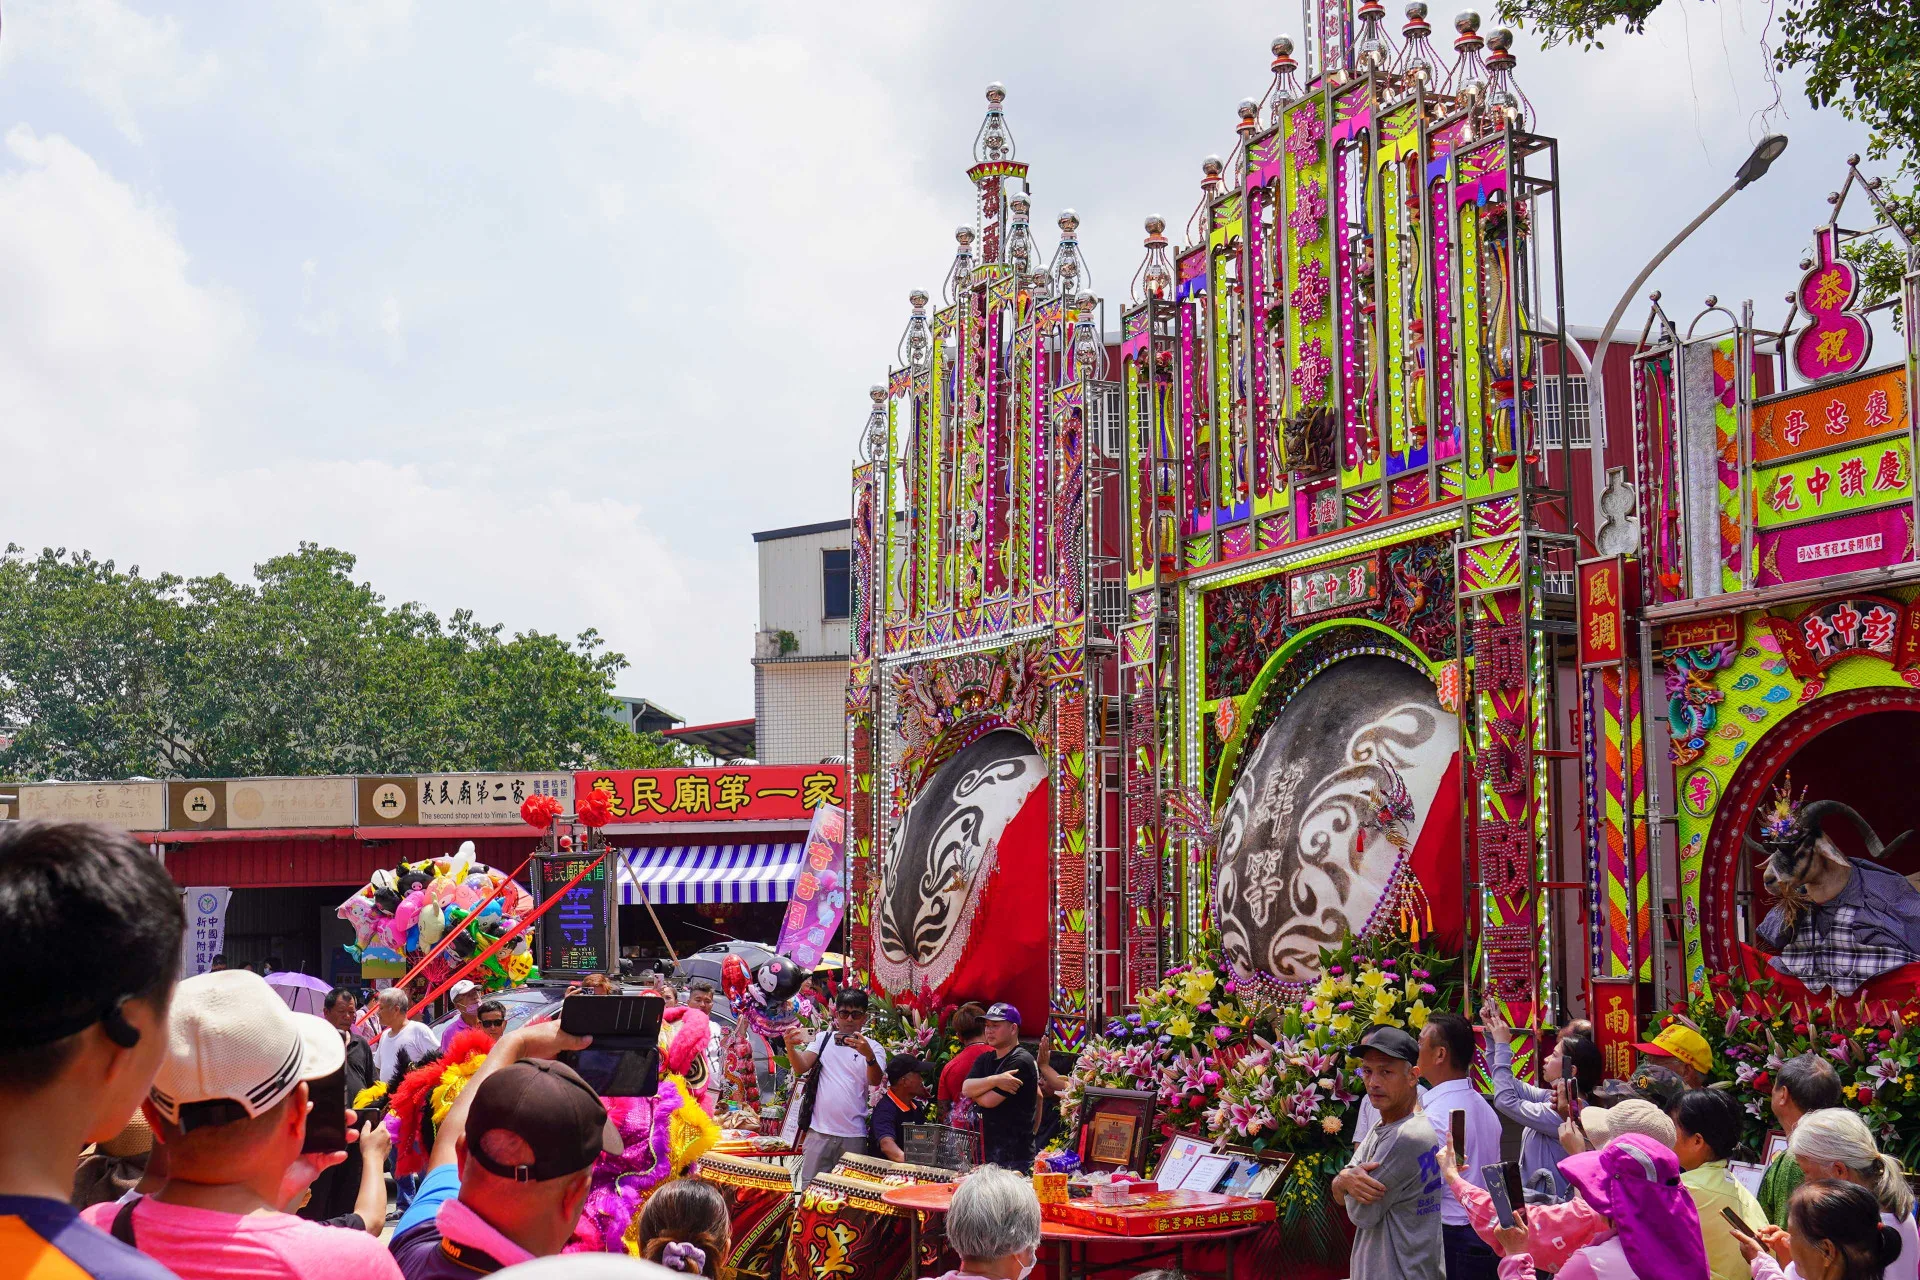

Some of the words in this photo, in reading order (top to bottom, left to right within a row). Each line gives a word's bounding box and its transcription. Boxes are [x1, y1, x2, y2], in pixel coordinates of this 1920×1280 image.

[1811, 269, 1853, 368] 恭祝
[1783, 390, 1893, 447] 褒忠亭
[1772, 450, 1908, 512] 慶讚中元
[1303, 565, 1365, 609] 彭中平
[1588, 568, 1617, 653] 風調
[1804, 604, 1896, 656] 彭中平
[421, 811, 432, 819] The
[433, 811, 454, 819] second
[455, 811, 470, 820] shop
[491, 811, 507, 819] Yimin
[422, 779, 525, 805] 義民廟第二家
[1604, 995, 1631, 1079] 雨順
